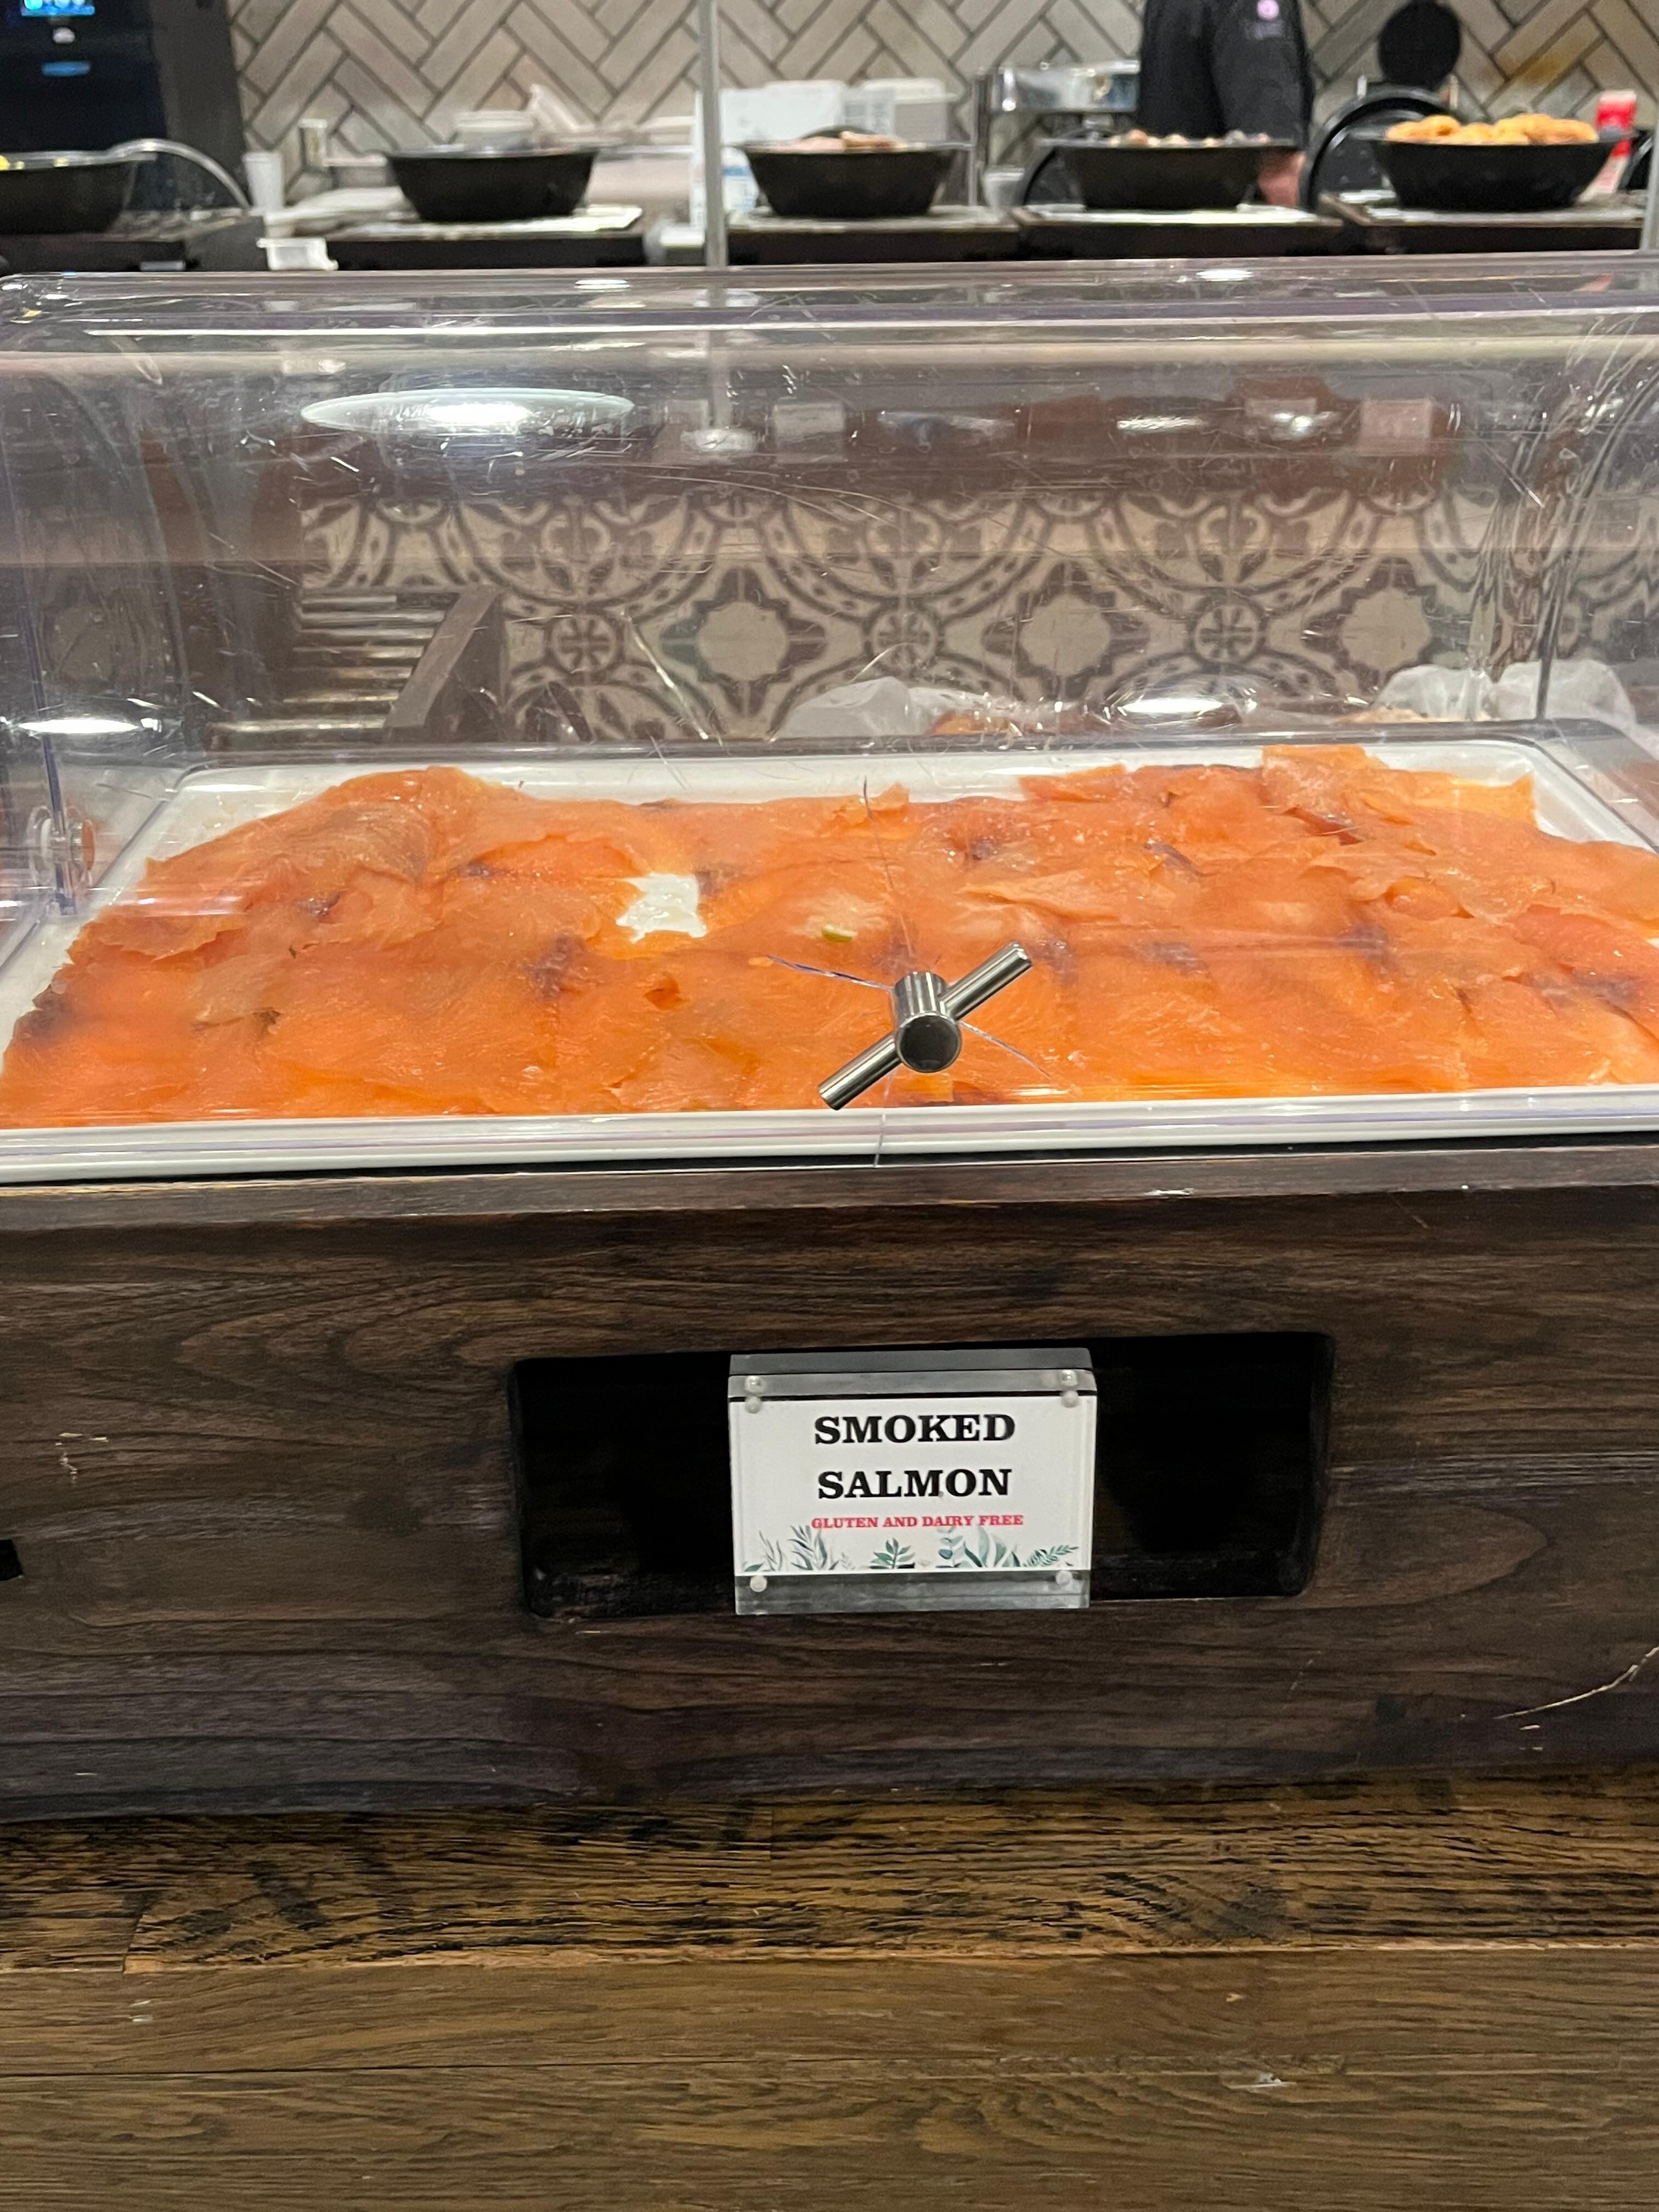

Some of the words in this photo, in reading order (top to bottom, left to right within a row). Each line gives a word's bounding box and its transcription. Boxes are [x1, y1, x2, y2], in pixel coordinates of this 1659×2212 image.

[814, 1413, 1015, 1444] SMOKED
[818, 1469, 1012, 1499] SALMON
[811, 1517, 878, 1529] GLUTEN
[883, 1516, 918, 1528] AND
[922, 1515, 973, 1527] DAIRY
[978, 1514, 1024, 1526] FREE
